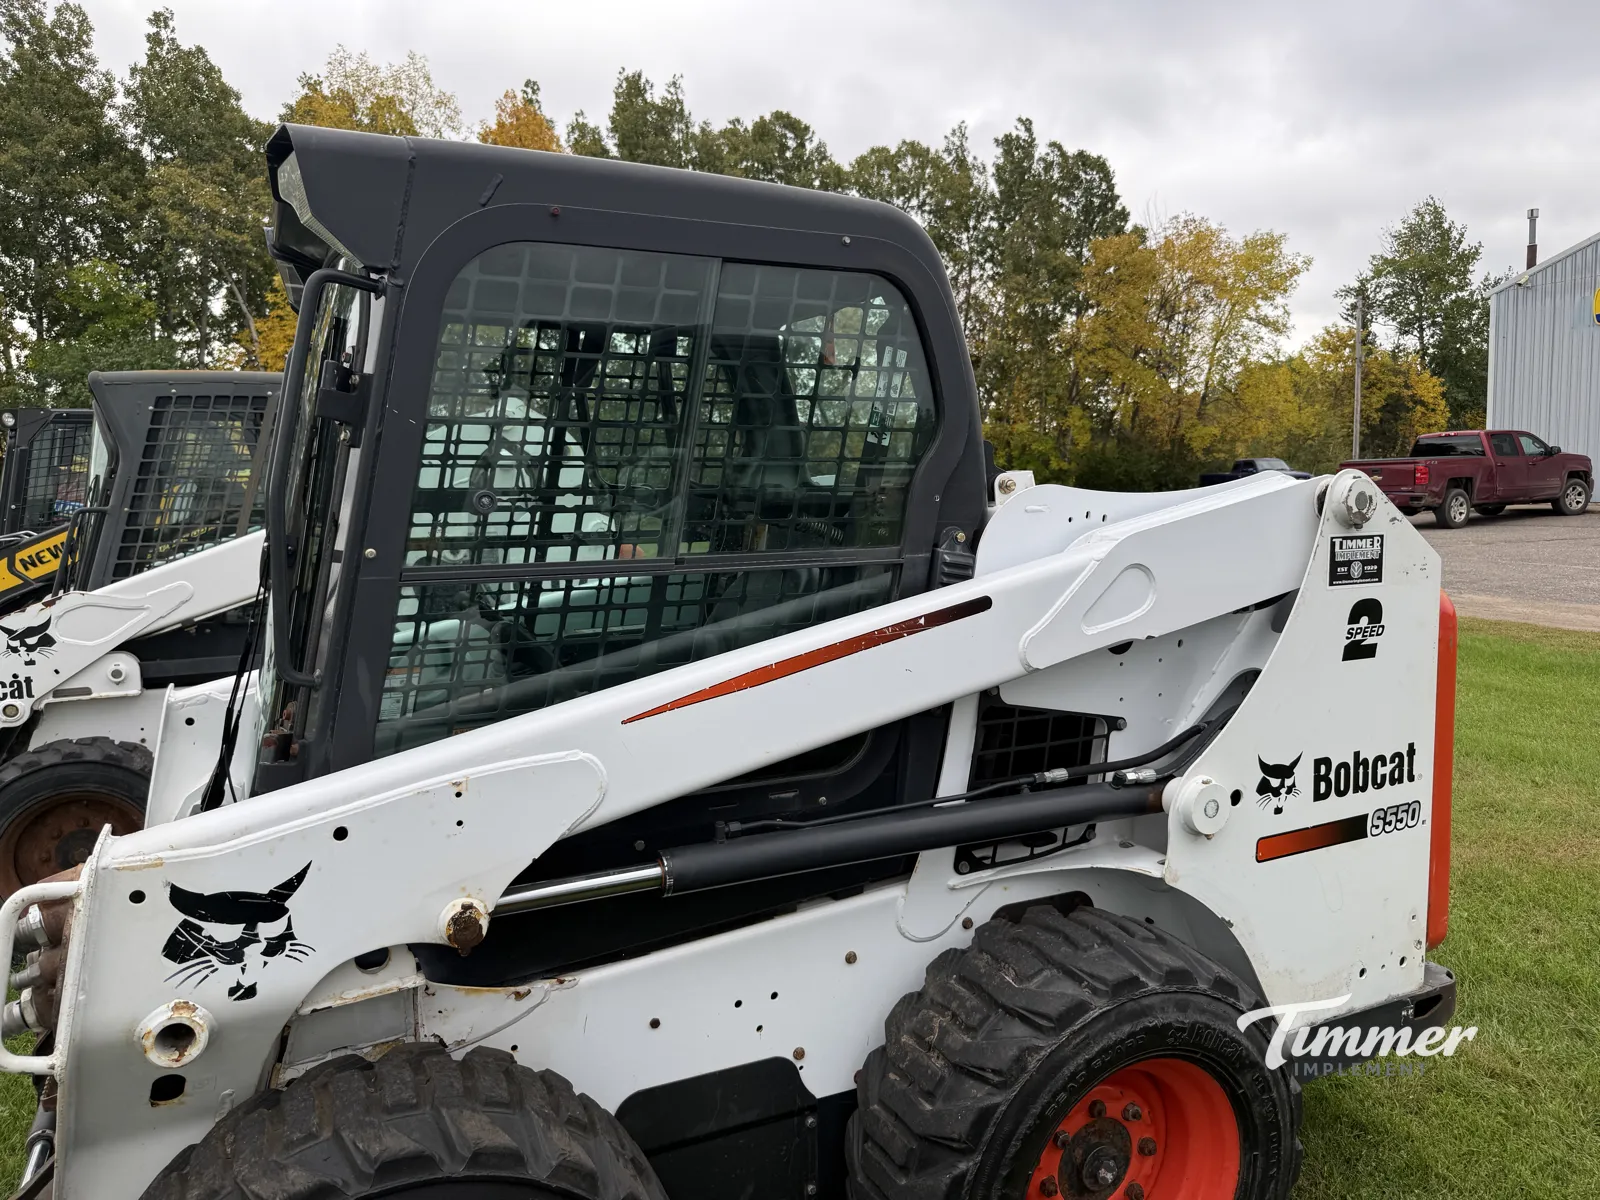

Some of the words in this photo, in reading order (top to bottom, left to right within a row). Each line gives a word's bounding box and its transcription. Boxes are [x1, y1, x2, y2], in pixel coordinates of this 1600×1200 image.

[19, 541, 65, 572] NEW
[1332, 536, 1381, 552] TIMMER
[1335, 550, 1381, 561] IMPLEMENT
[1342, 598, 1383, 661] 2
[1345, 624, 1386, 640] SPEED
[1313, 742, 1416, 802] Bobcat
[1370, 800, 1421, 837] S550
